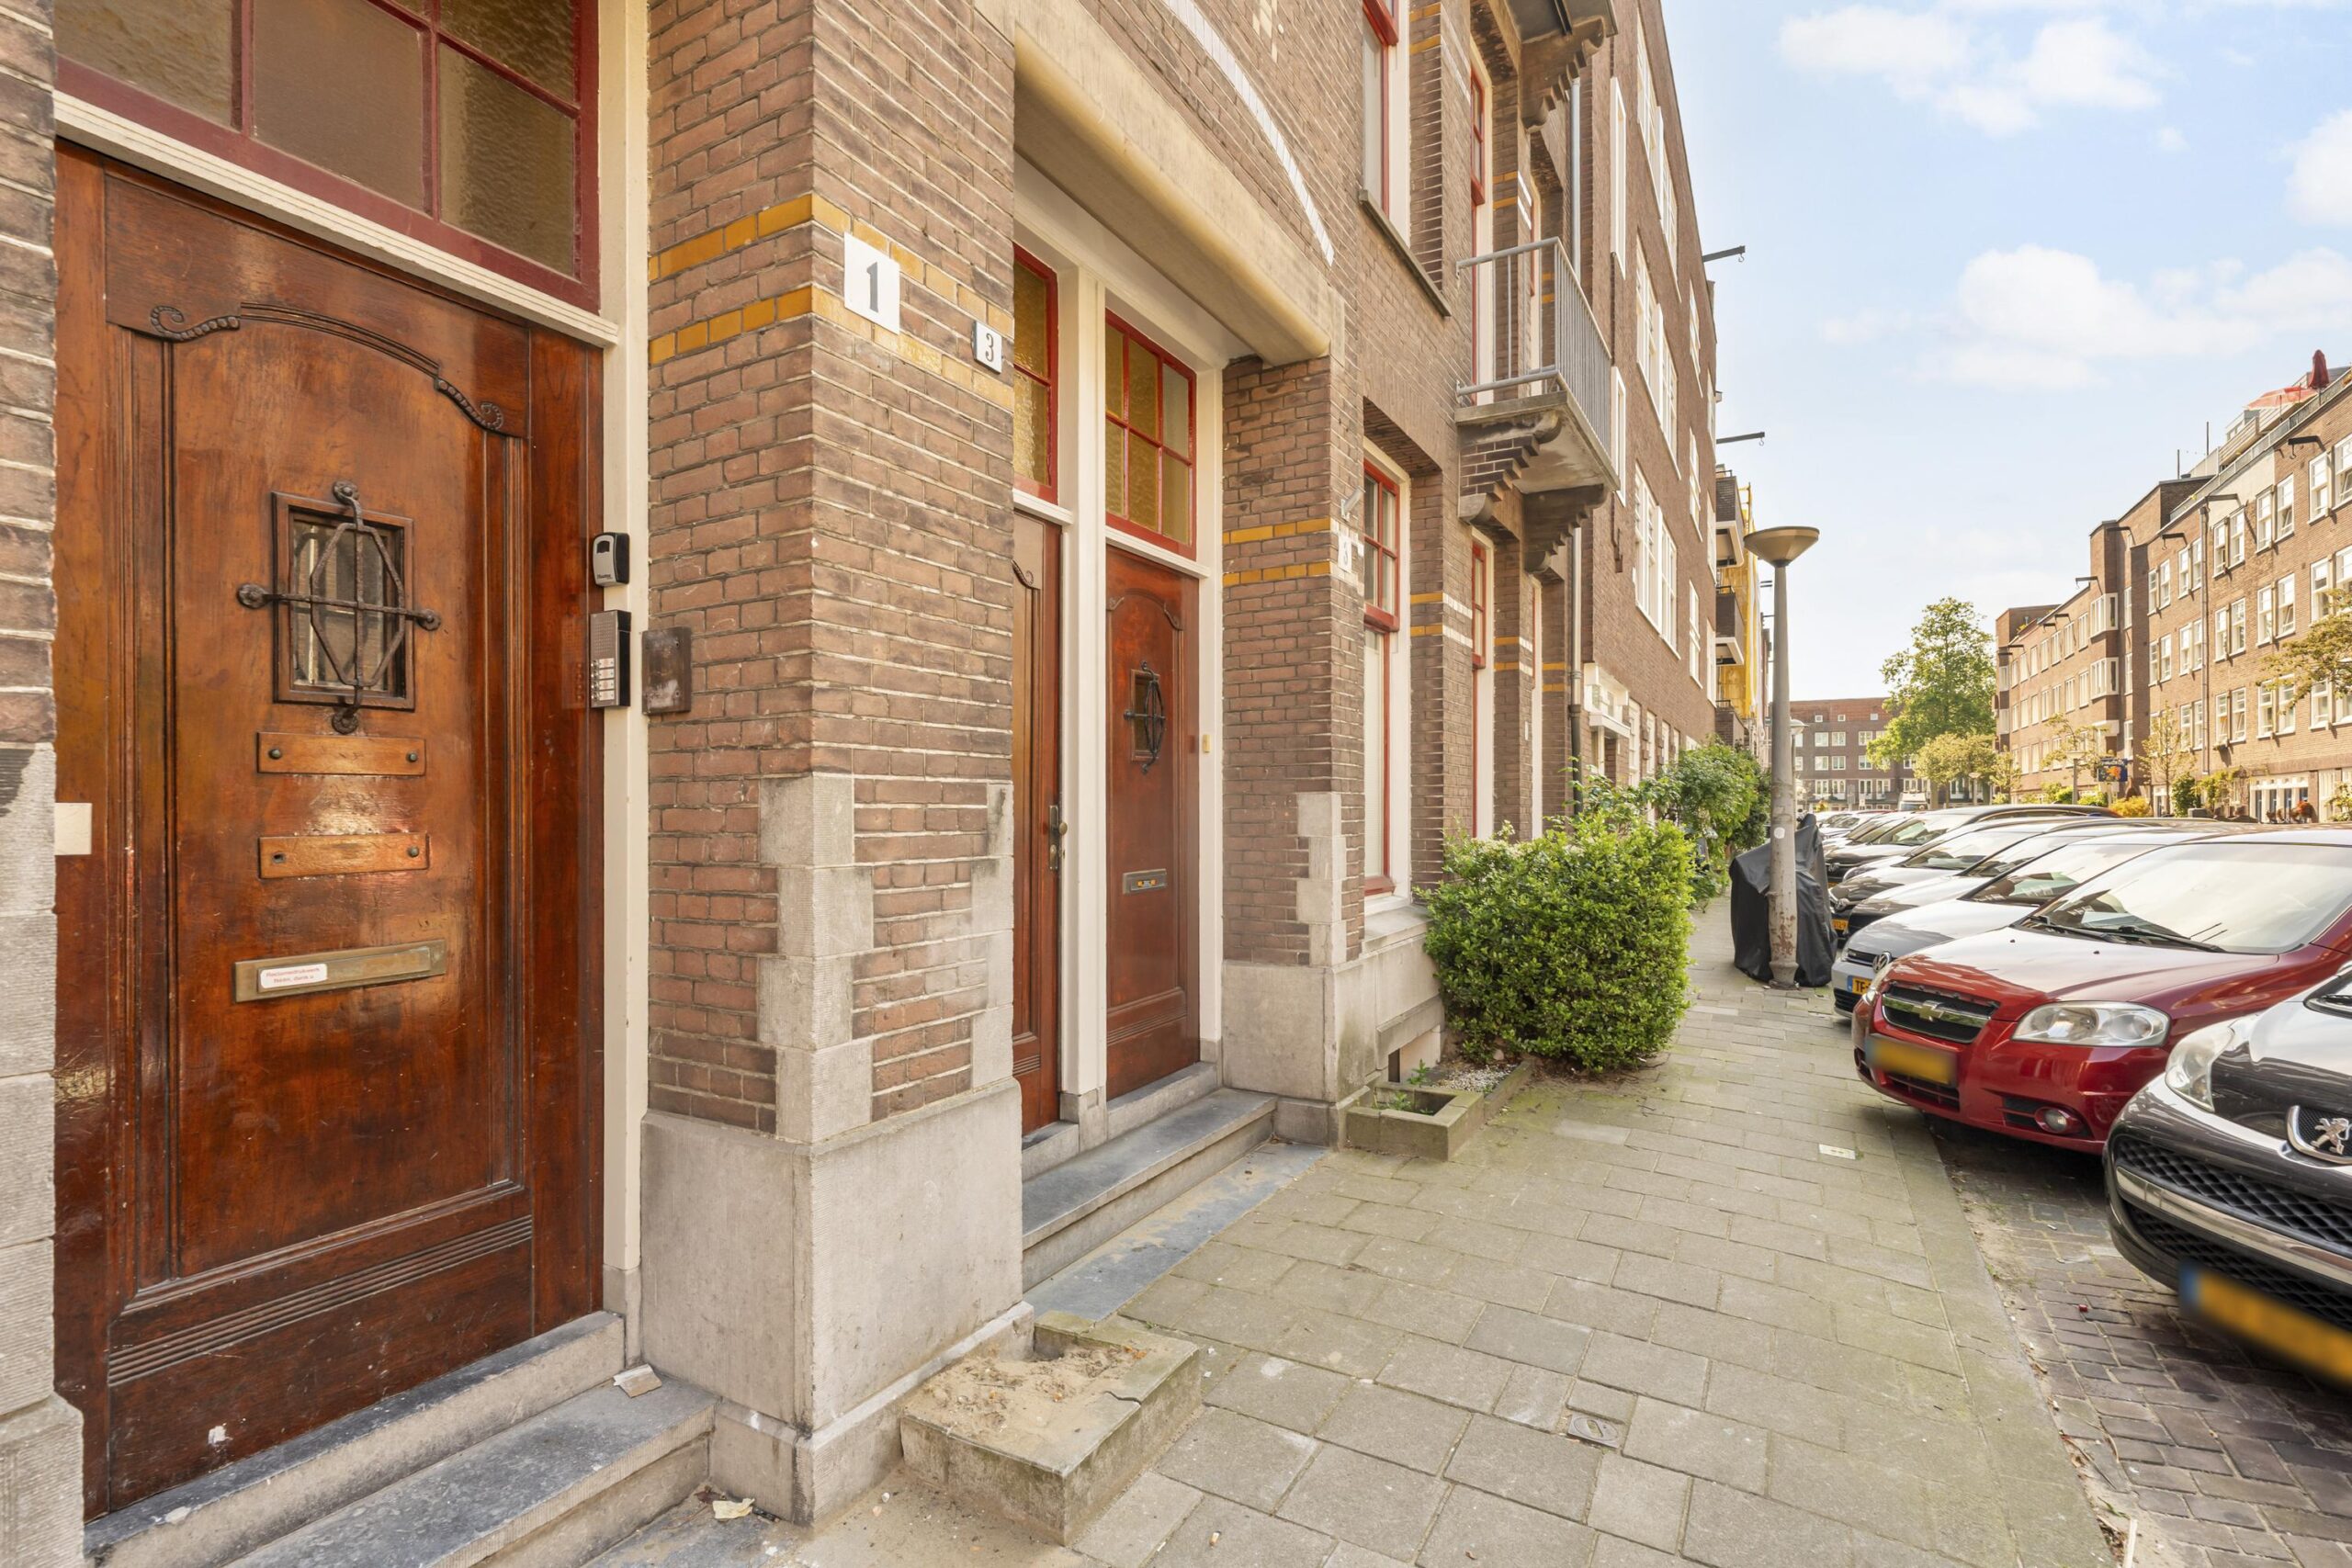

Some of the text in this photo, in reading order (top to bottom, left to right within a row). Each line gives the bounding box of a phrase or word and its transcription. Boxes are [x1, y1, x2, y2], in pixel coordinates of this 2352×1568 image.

[866, 261, 879, 313] 1
[985, 333, 994, 362] 3
[1854, 979, 1871, 993] TF-
